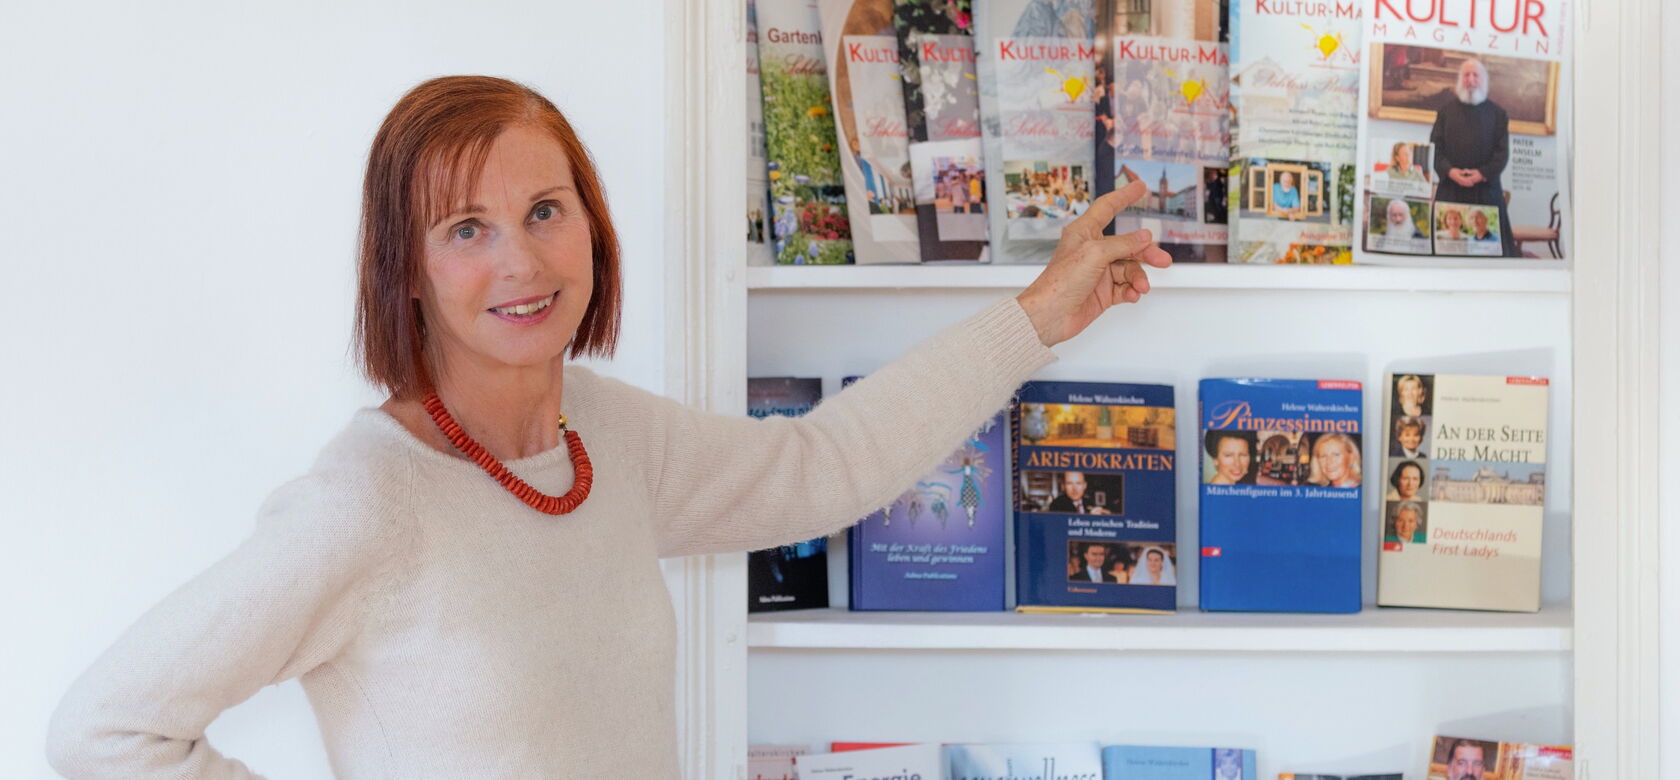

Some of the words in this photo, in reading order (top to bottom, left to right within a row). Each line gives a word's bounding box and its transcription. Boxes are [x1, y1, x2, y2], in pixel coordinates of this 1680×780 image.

[1373, 0, 1548, 37] KULTUR
[1373, 23, 1549, 55] MAGAZIN
[1282, 403, 1306, 412] Helene
[1208, 400, 1359, 433] Prinzessinnen
[1437, 423, 1460, 440] AN
[1466, 427, 1495, 442] DER
[1500, 425, 1544, 444] SEITE
[1436, 446, 1466, 461] DER
[1471, 445, 1532, 463] MACHT
[1027, 451, 1174, 472] ARISTOKRATEN
[1207, 486, 1278, 498] Märchenfiguren
[1280, 488, 1292, 497] im
[1305, 488, 1359, 499] Jahrtausend
[1068, 518, 1090, 527] Leben
[1092, 519, 1124, 528] zwischen
[1126, 519, 1159, 529] Tradition
[1068, 528, 1083, 537] und
[1084, 528, 1117, 538] Moderne
[1432, 528, 1517, 542] Deutschlands
[889, 542, 904, 552] der
[949, 544, 988, 555] Friedens
[1432, 545, 1459, 555] First
[1464, 546, 1499, 559] Ladys
